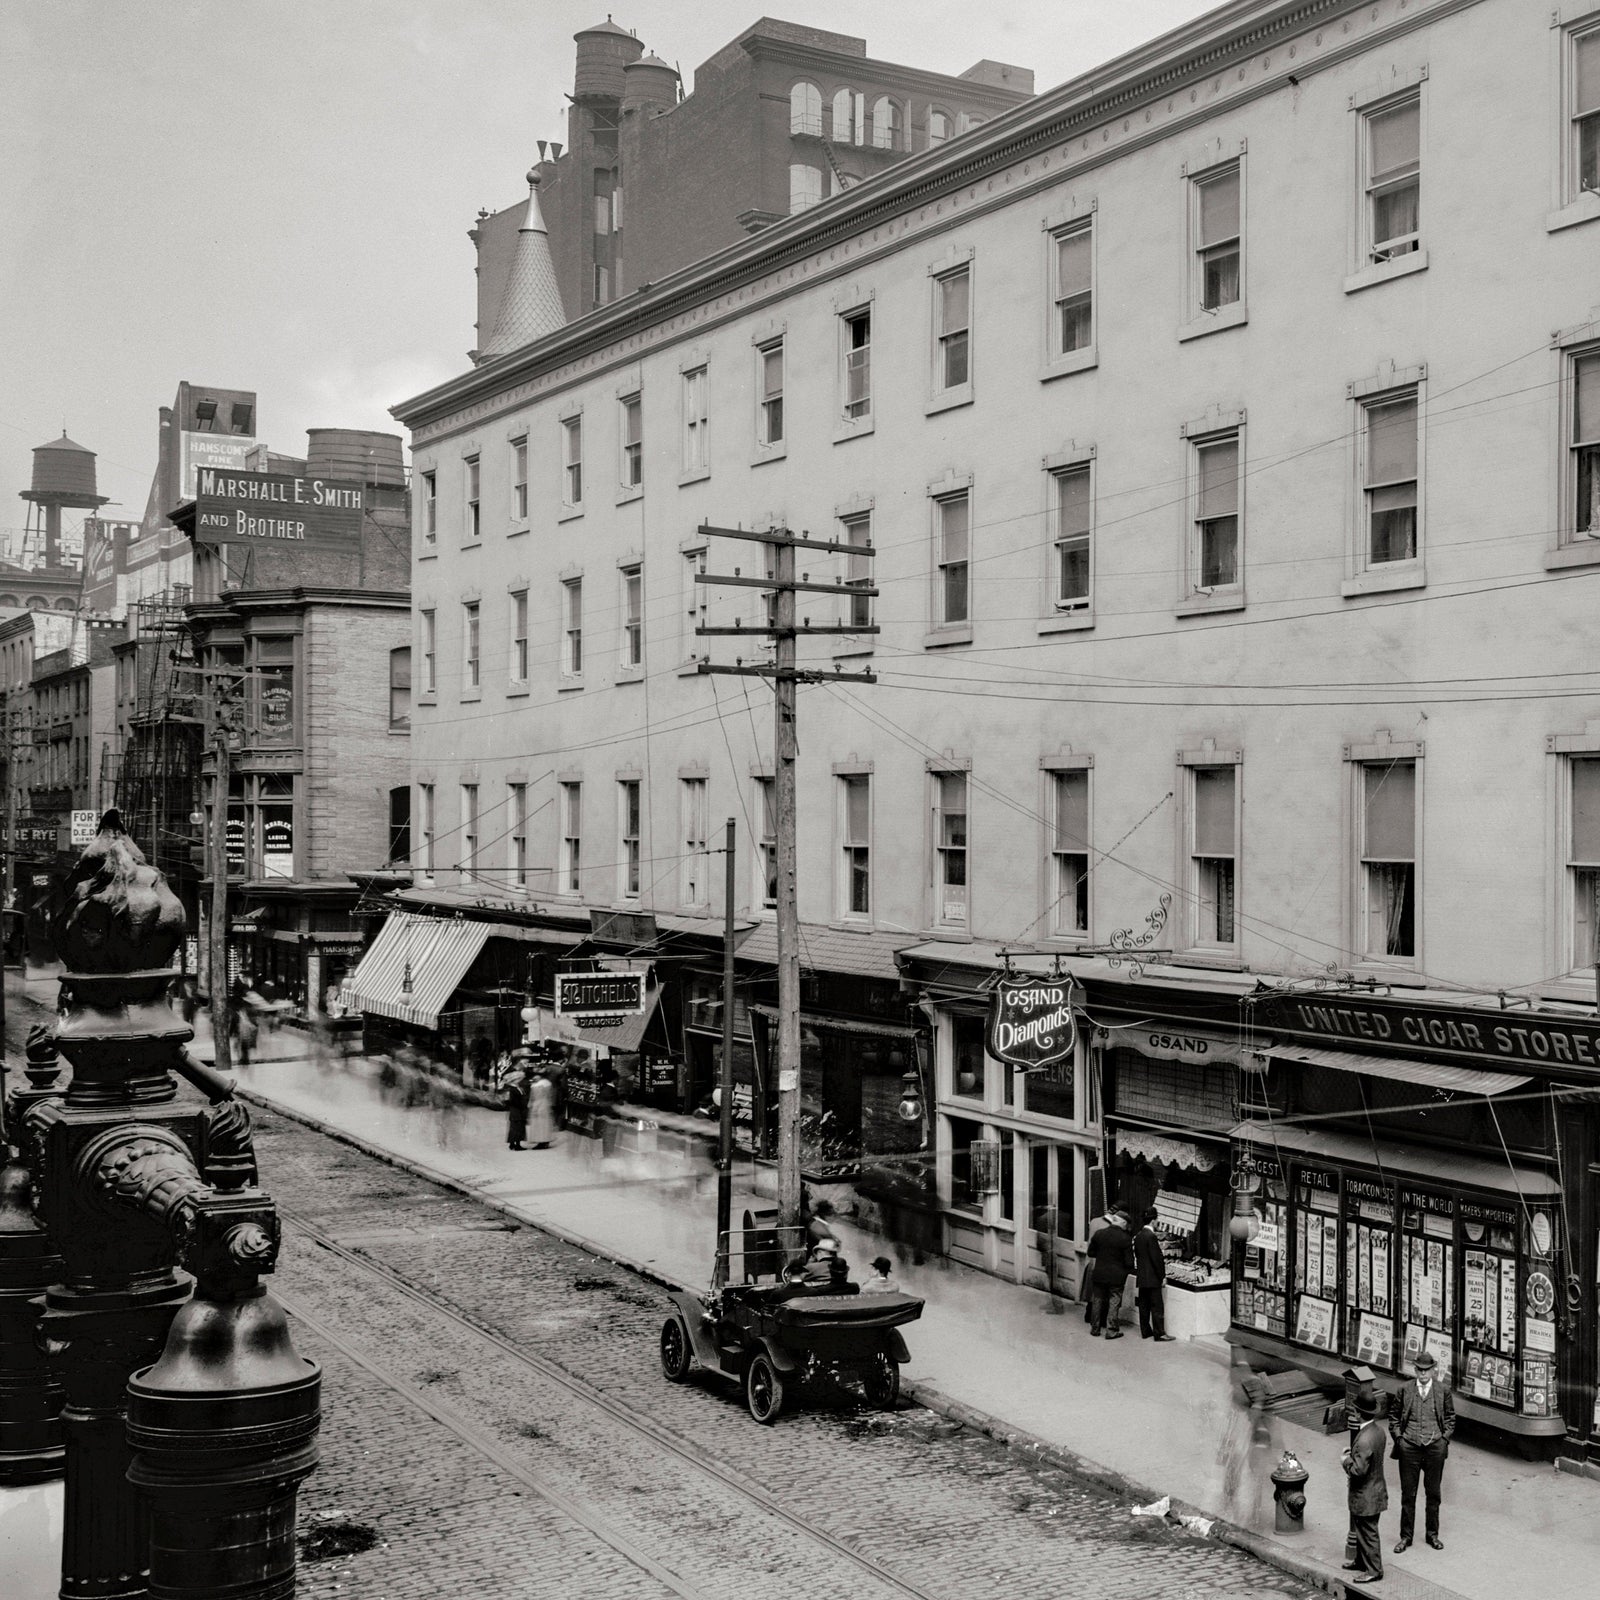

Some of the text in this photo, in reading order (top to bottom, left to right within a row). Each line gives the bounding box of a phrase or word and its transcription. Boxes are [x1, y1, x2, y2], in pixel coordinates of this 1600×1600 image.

[208, 455, 233, 464] FINE
[201, 469, 362, 509] MARSHALL E. SMITH
[200, 509, 305, 540] AND BROTHER
[73, 812, 94, 822] FOR
[32, 829, 57, 841] RYE
[561, 981, 639, 1005] MITCHELL'S
[580, 1017, 622, 1027] DIAMONDS
[999, 1005, 1070, 1052] Diamonds
[1297, 1004, 1392, 1039] UNITED
[1402, 1016, 1484, 1050] CIGAR
[1149, 1034, 1208, 1054] GSAND
[1250, 1158, 1280, 1176] RGEST
[1301, 1170, 1331, 1188] RETAIL
[1346, 1179, 1394, 1201] TOBACCONISTS
[1402, 1191, 1453, 1214] IN THE WORLD
[1310, 1259, 1319, 1270] 25
[1470, 1299, 1483, 1310] 25
